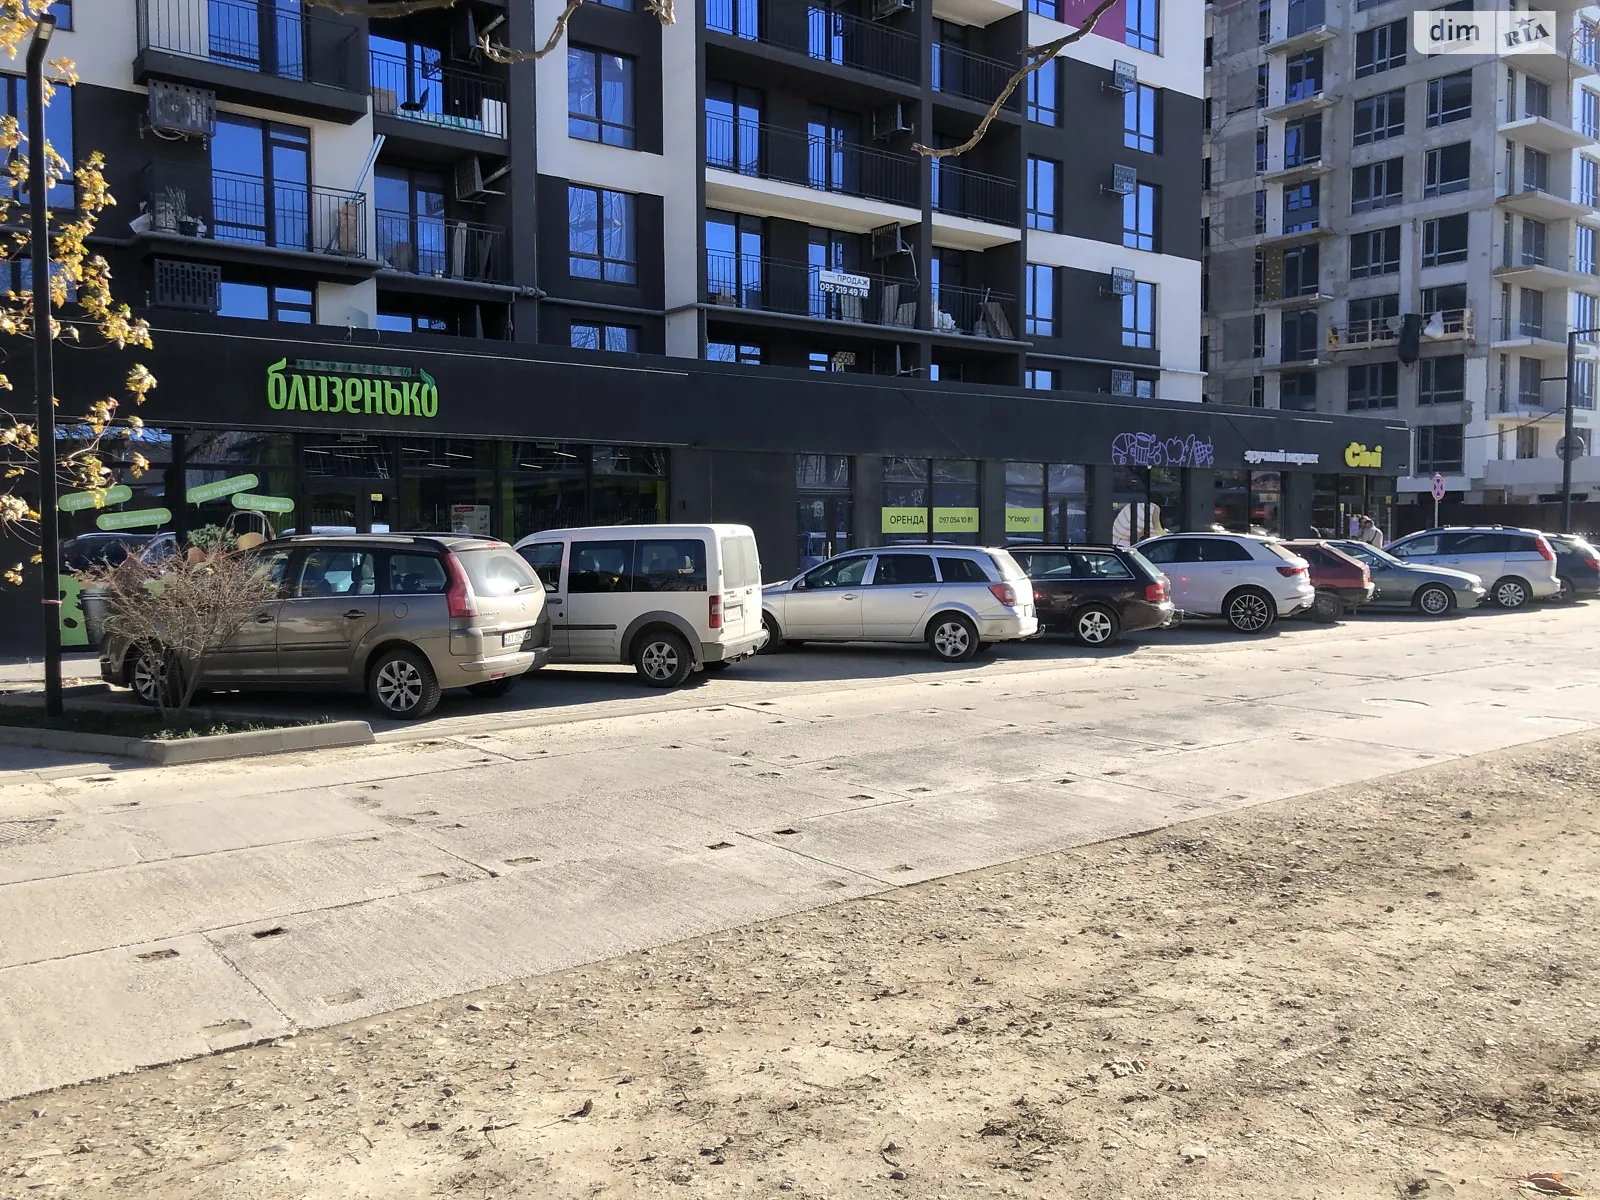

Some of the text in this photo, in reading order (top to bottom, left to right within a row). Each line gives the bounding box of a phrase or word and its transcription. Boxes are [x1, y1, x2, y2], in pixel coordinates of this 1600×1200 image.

[837, 275, 869, 286] ПРОДАЖ
[820, 282, 869, 297] 095 219 49 78
[267, 357, 438, 417] близенько
[889, 515, 925, 525] ОРЕНДА
[939, 516, 950, 524] 097
[950, 516, 960, 524] 054
